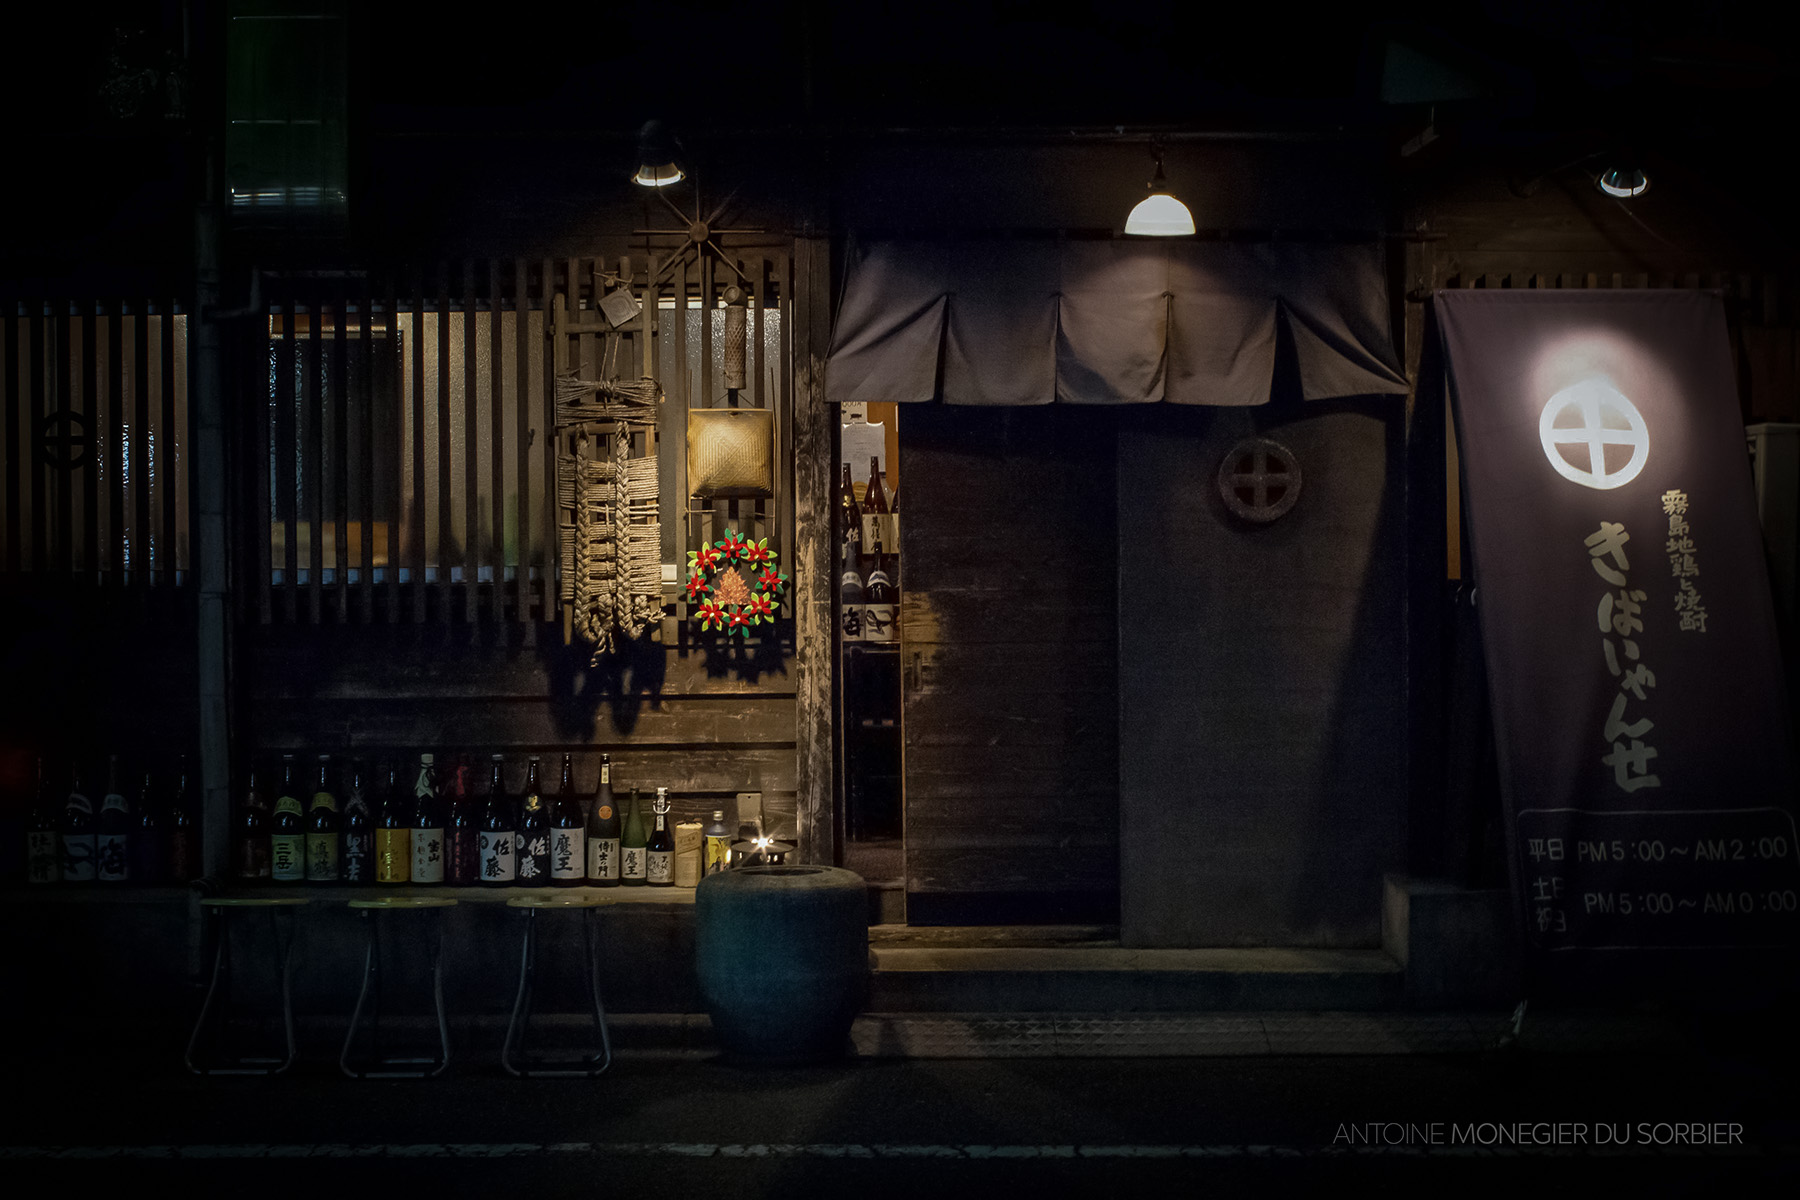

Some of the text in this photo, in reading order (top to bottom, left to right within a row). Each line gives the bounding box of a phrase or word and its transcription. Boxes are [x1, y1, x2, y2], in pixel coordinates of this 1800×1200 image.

[1661, 489, 1708, 633] 霧島地鶏と焼酎
[276, 842, 293, 870] 三岳
[485, 837, 511, 878] 佐藤
[519, 836, 547, 879] 佐藤
[554, 833, 573, 872] 魔王
[598, 841, 610, 878] 侍士の門
[624, 850, 639, 876] 魔王
[1528, 838, 1565, 863] 平日
